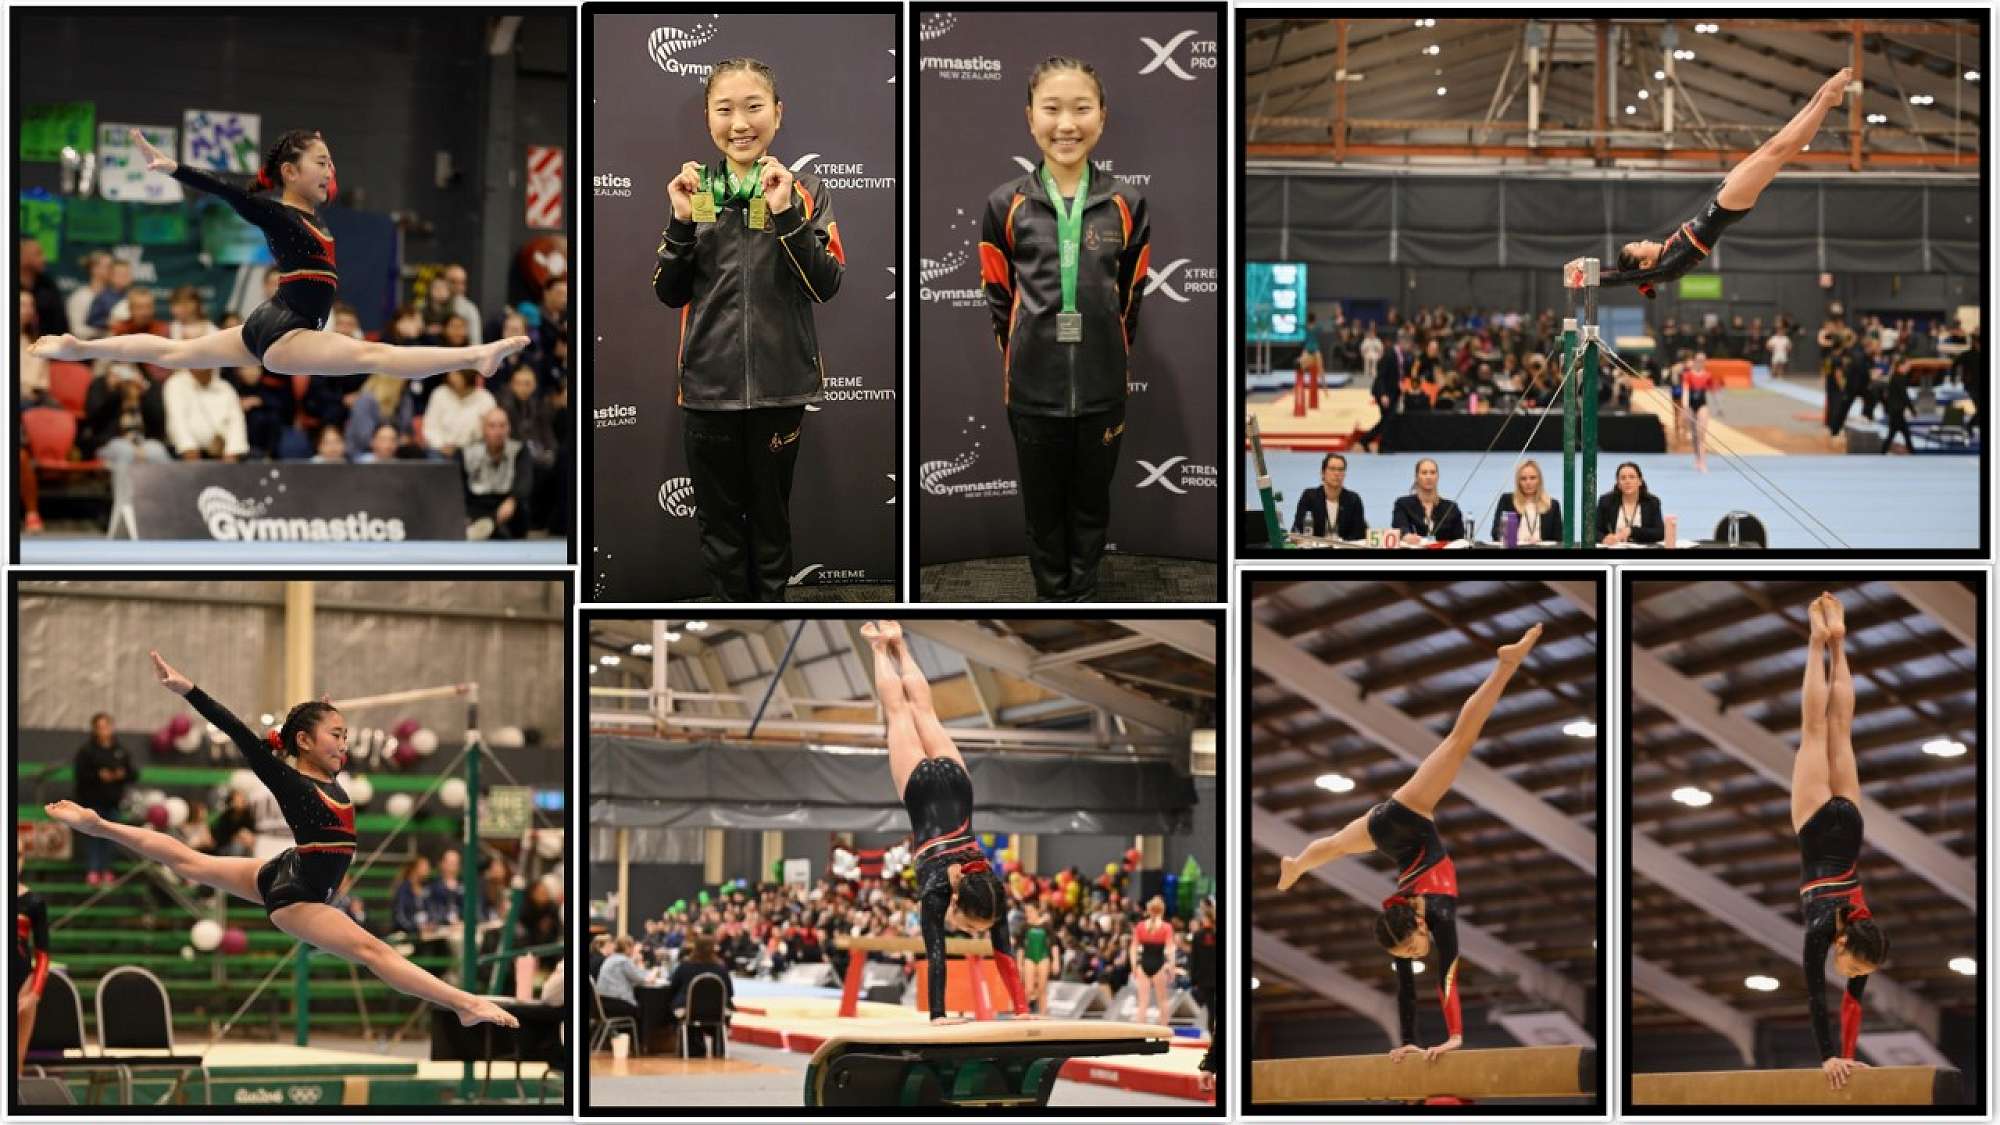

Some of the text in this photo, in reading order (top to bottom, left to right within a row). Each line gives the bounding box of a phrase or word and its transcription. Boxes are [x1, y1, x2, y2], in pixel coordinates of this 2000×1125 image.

[814, 163, 864, 175] XTREME
[934, 478, 1018, 496] Gymnastics
[208, 511, 406, 540] Gymnastics
